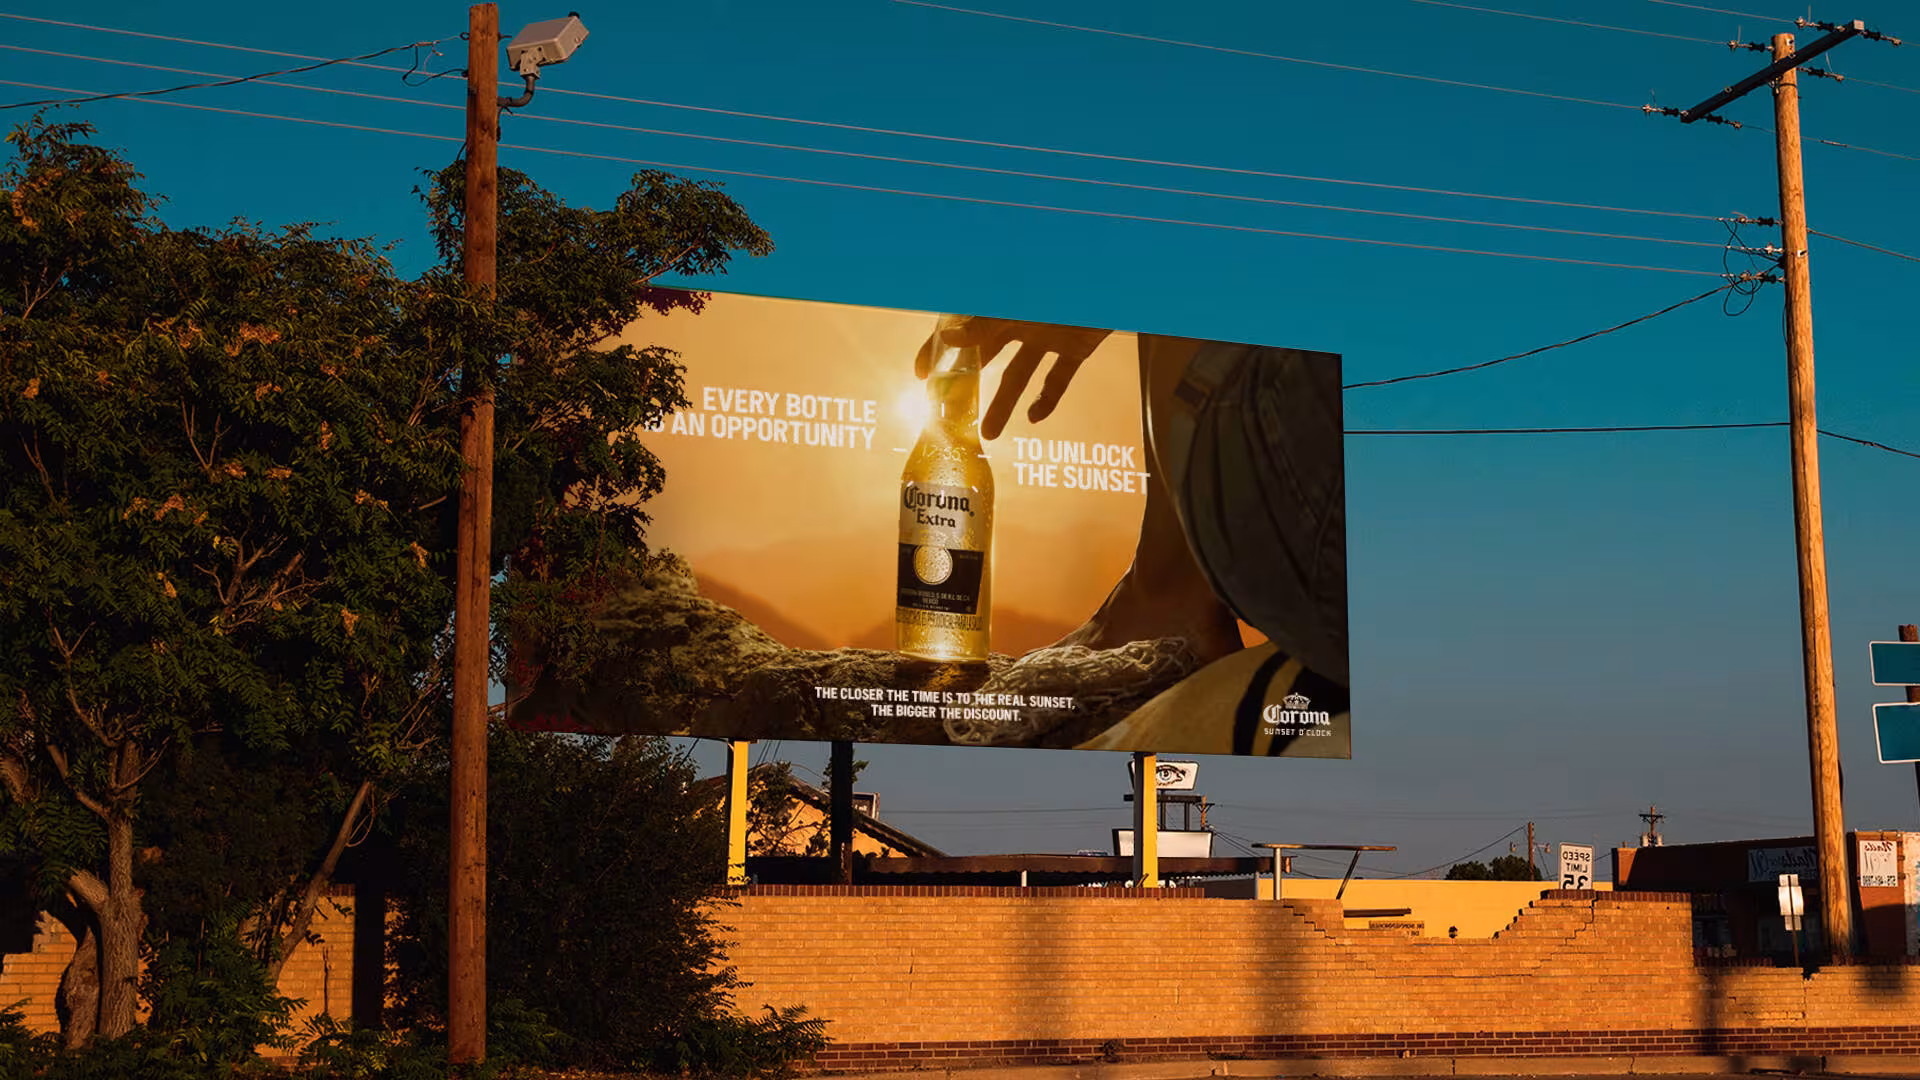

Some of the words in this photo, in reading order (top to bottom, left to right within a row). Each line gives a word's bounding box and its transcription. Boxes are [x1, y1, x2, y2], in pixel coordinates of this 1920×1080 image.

[703, 386, 780, 416] EVERY
[786, 393, 878, 424] BOTTLE
[671, 411, 706, 437] AN
[711, 413, 878, 449] OPPORTUNITY
[1013, 437, 1043, 461] TO
[1048, 439, 1136, 469] UNLOCK
[1013, 462, 1059, 488] THE
[1063, 465, 1151, 496] SUNSET
[903, 485, 971, 513] Corona
[916, 507, 957, 528] Extra
[814, 686, 838, 699] THE
[840, 687, 884, 701] CLOSER
[886, 689, 909, 702] THE
[911, 690, 940, 704] TIME
[942, 691, 953, 704] IS
[956, 692, 970, 705] TO
[973, 693, 996, 706] THE
[997, 694, 1027, 707] REAL
[871, 704, 894, 717] THE
[896, 704, 937, 718] BIGGER
[939, 707, 962, 720] THE
[963, 708, 1022, 722] DISCOUNT.
[1262, 703, 1331, 726] Corona
[1263, 727, 1295, 736] SUNSET
[1298, 728, 1332, 737] O'CLOCK
